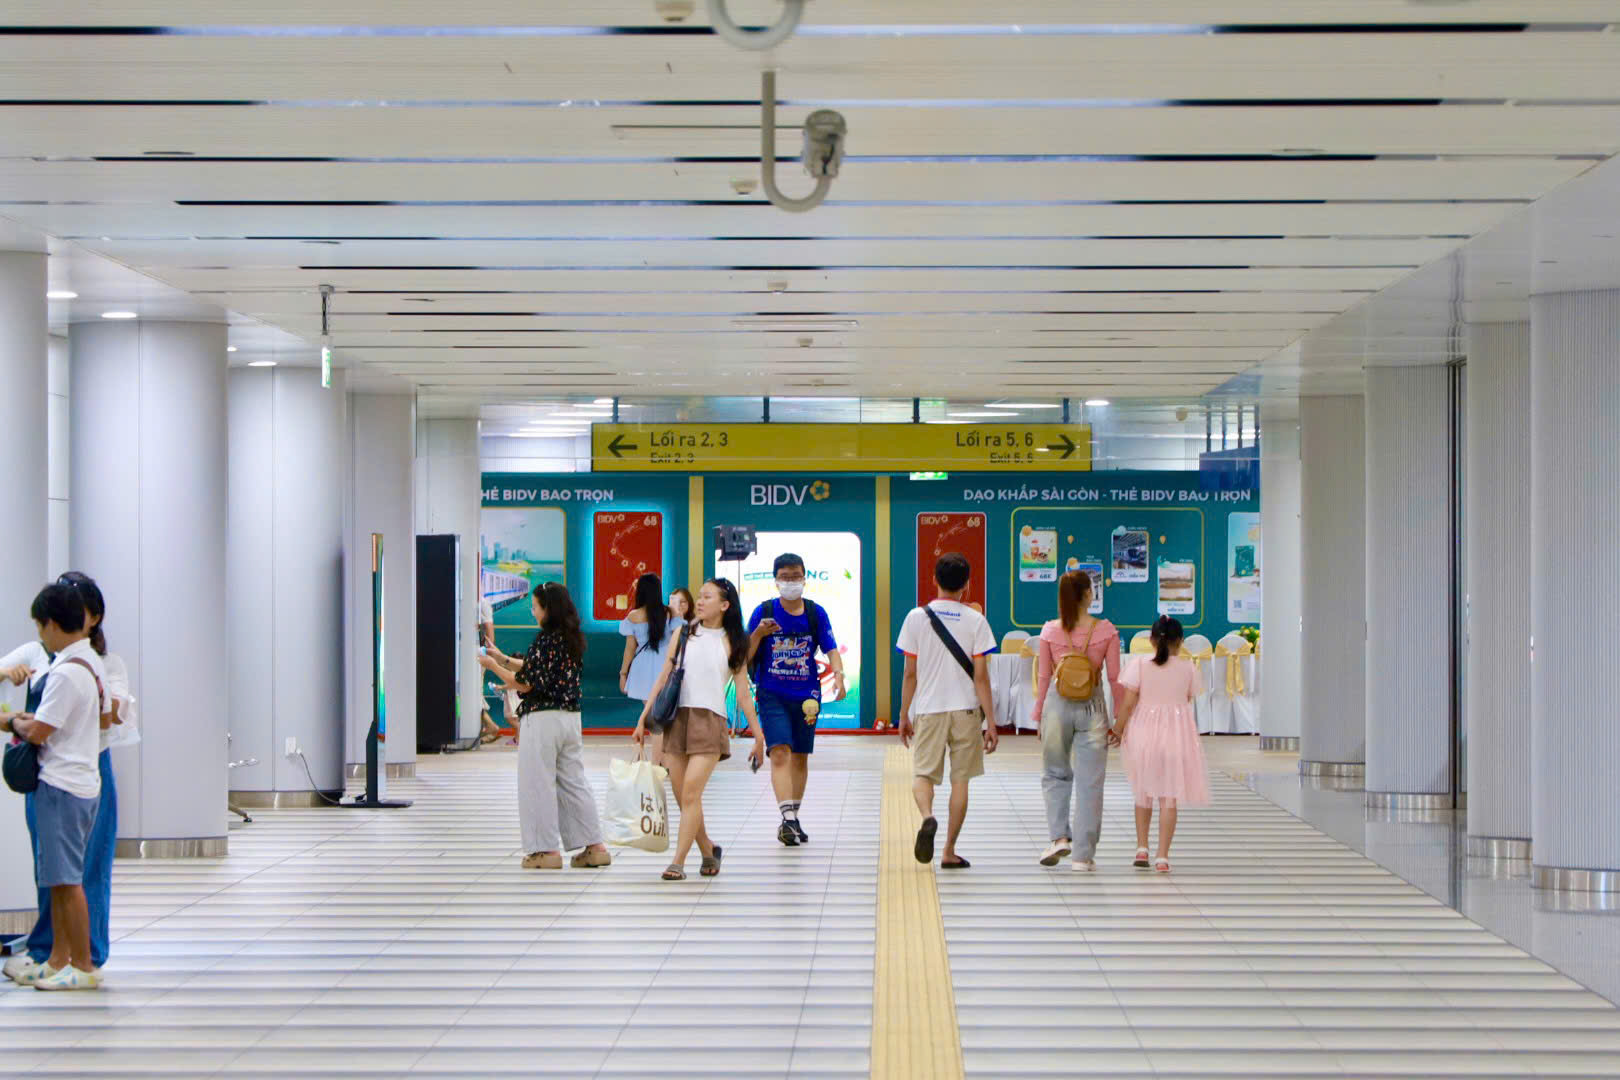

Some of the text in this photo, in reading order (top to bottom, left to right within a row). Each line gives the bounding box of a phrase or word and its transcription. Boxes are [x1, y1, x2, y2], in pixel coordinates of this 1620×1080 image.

[650, 429, 729, 448] Lối ra 2, 3
[956, 429, 1034, 448] Lối ra 5, 6
[480, 486, 614, 504] HẺ BIDV BAO TRỌN
[750, 484, 809, 506] BIDV
[963, 489, 995, 504] DẠO
[998, 483, 1038, 501] KHẮP
[1041, 486, 1064, 501] SÀI
[1067, 486, 1099, 501] GÒN
[1141, 489, 1175, 501] BIDV
[1179, 489, 1209, 501] BAO
[643, 515, 658, 527] 68
[967, 516, 981, 528] 68
